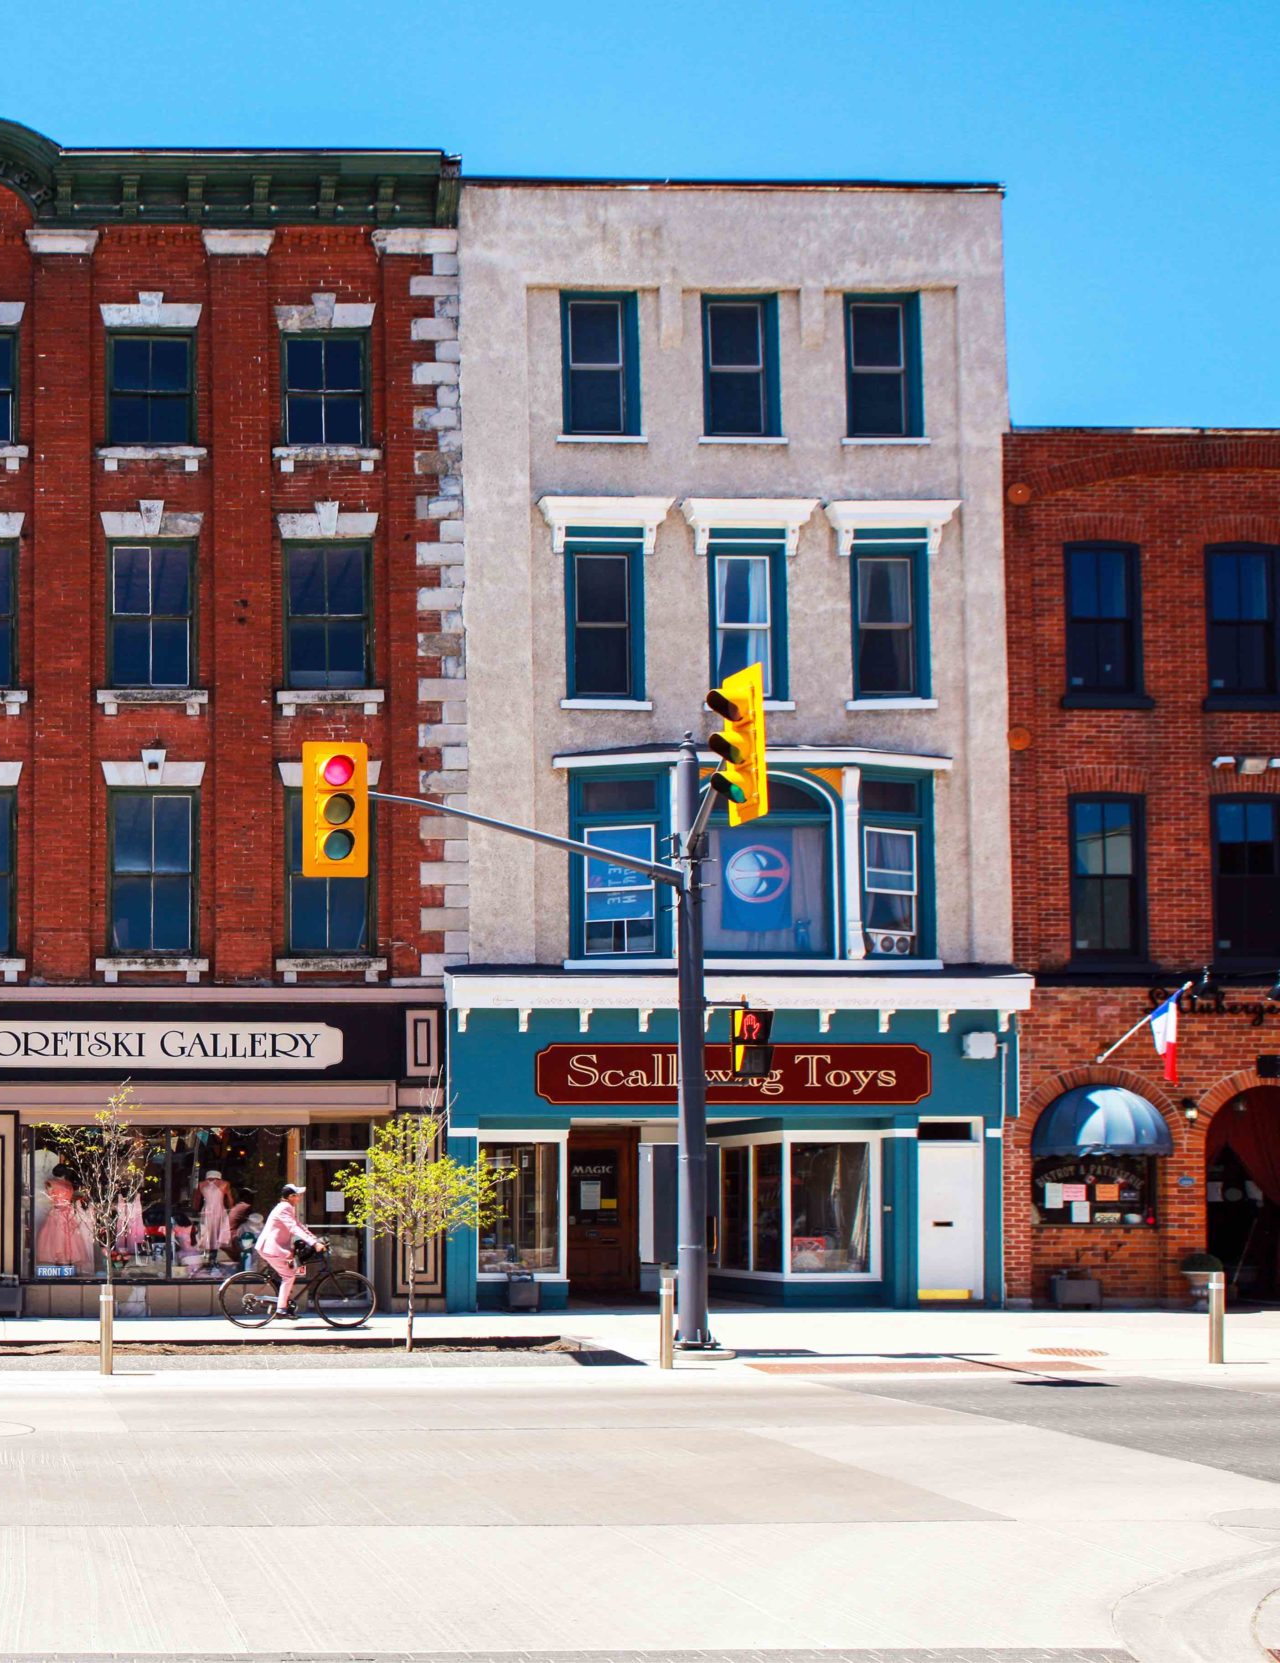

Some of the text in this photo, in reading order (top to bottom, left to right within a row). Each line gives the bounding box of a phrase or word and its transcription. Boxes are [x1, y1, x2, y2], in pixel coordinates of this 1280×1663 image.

[160, 1030, 320, 1058] GALLERY
[795, 1054, 897, 1094] Toys
[572, 1165, 613, 1174] MAGIC
[38, 1267, 73, 1276] FRONT ST
